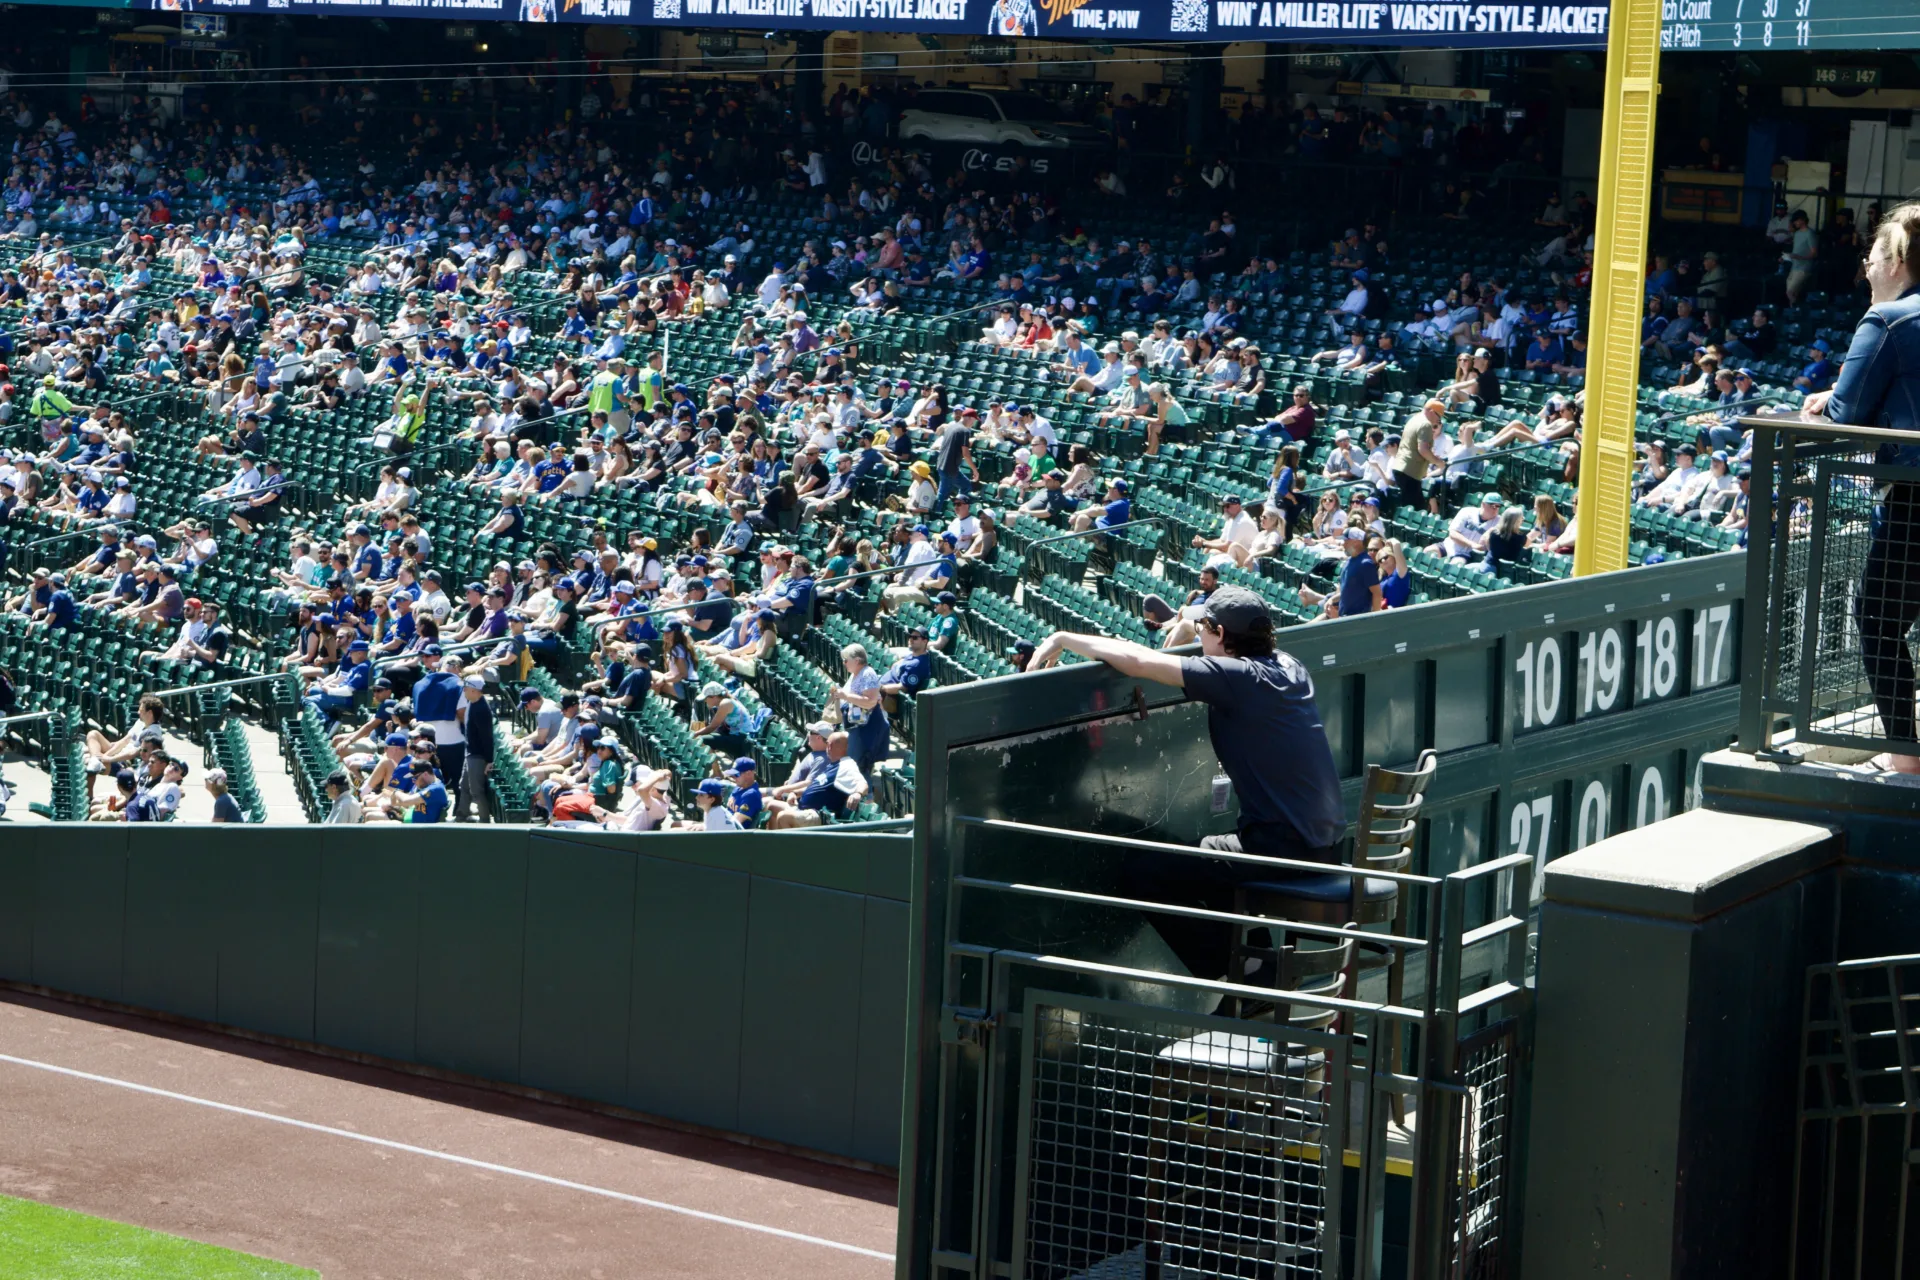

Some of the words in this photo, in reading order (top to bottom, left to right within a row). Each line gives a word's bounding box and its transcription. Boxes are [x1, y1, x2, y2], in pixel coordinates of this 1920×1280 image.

[607, 0, 631, 16] PNW
[728, 0, 775, 15] MILLER
[811, 0, 913, 19] VARSITY-STYLE
[914, 0, 968, 20] JACKET
[1258, 2, 1273, 27] A
[1275, 2, 1340, 29] MILLER
[1391, 4, 1536, 33] VARSITY-STYLE
[1537, 6, 1609, 34] JACKET
[1679, 0, 1712, 20] Count
[1735, 0, 1745, 18] 7
[1762, 0, 1778, 18] 30
[1795, 0, 1811, 17] 37
[1072, 9, 1106, 31] TIME,
[1108, 10, 1140, 29] PNW
[1674, 22, 1701, 48] Pitch
[1733, 22, 1743, 47] 3
[1763, 21, 1773, 47] 8
[1796, 20, 1809, 46] 11
[1816, 68, 1837, 82] 146
[1856, 70, 1877, 83] 147
[1516, 636, 1561, 729] 10
[1580, 627, 1622, 713] 19
[1637, 616, 1677, 700] 18
[1693, 604, 1732, 687] 17
[1507, 794, 1553, 909] 27
[1578, 780, 1606, 850] 0
[1637, 766, 1664, 828] 0
